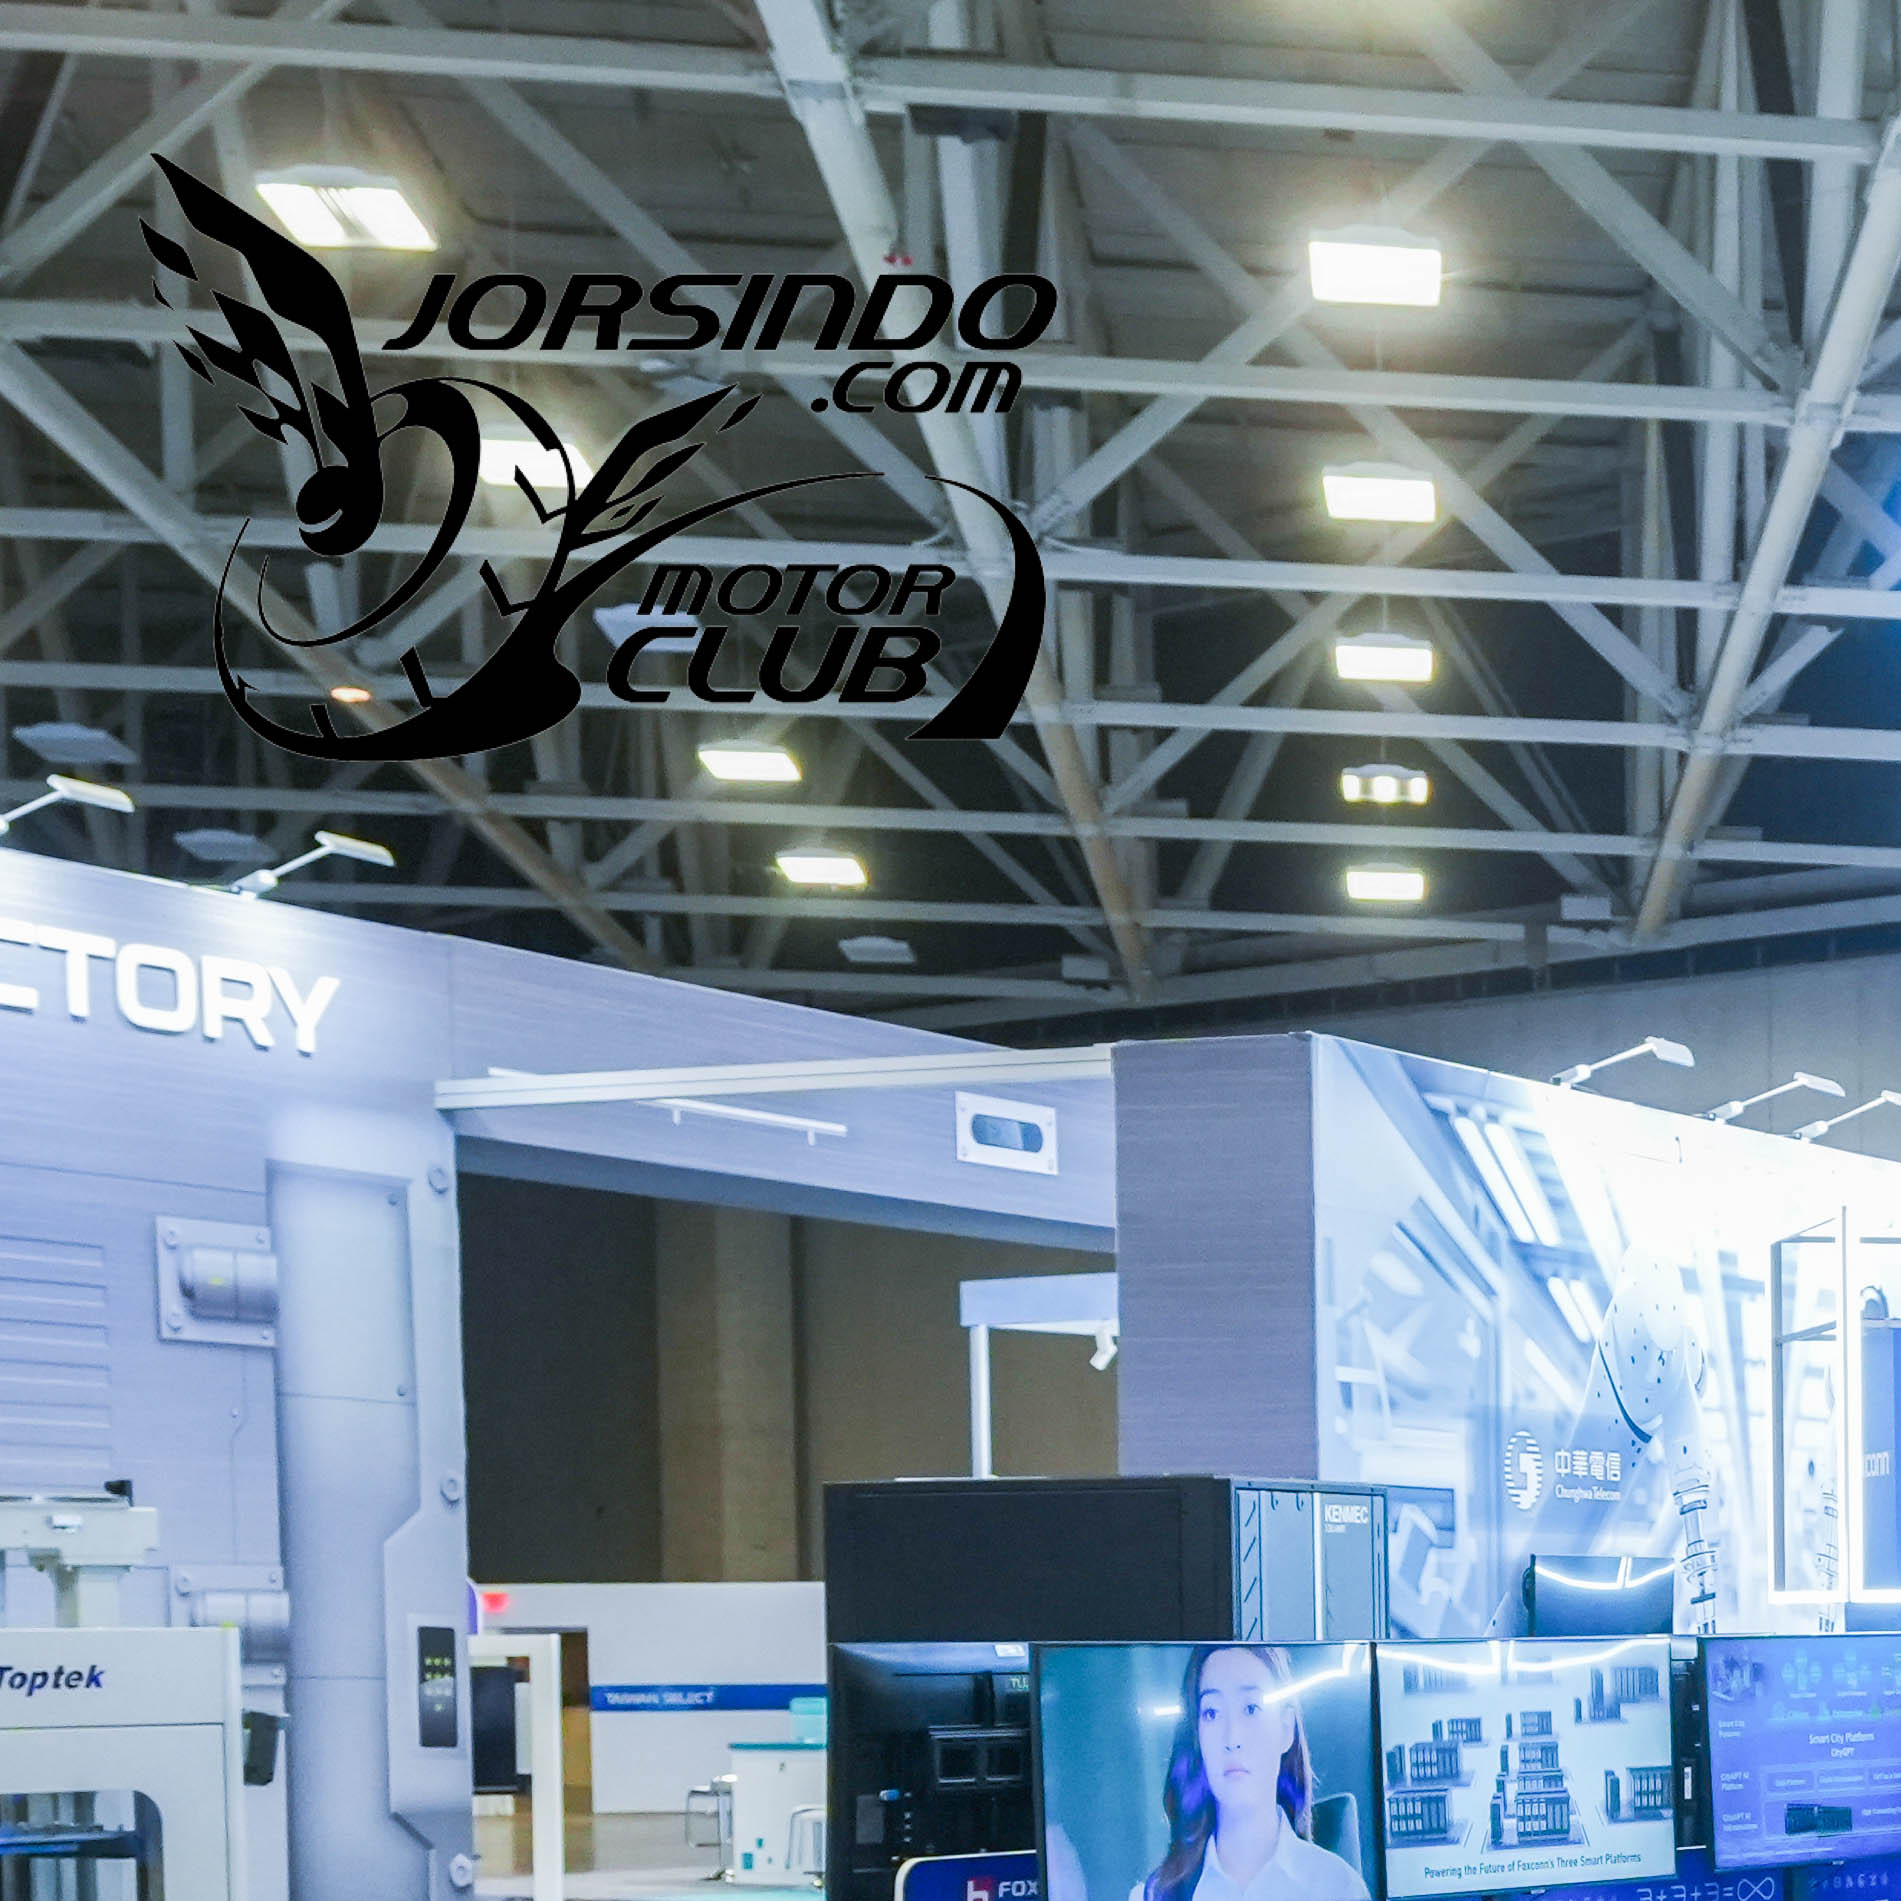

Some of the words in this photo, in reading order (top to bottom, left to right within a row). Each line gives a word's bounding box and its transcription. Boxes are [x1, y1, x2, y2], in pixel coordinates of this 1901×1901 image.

[1554, 1449, 1622, 1481] 中華電信
[1424, 1865, 1462, 1879] Powering
[1464, 1865, 1477, 1876] the
[1479, 1863, 1505, 1875] Future
[1507, 1861, 1515, 1872] of
[1557, 1856, 1578, 1868] Three
[1580, 1855, 1603, 1867] Smart
[1605, 1853, 1642, 1865] Platforms
